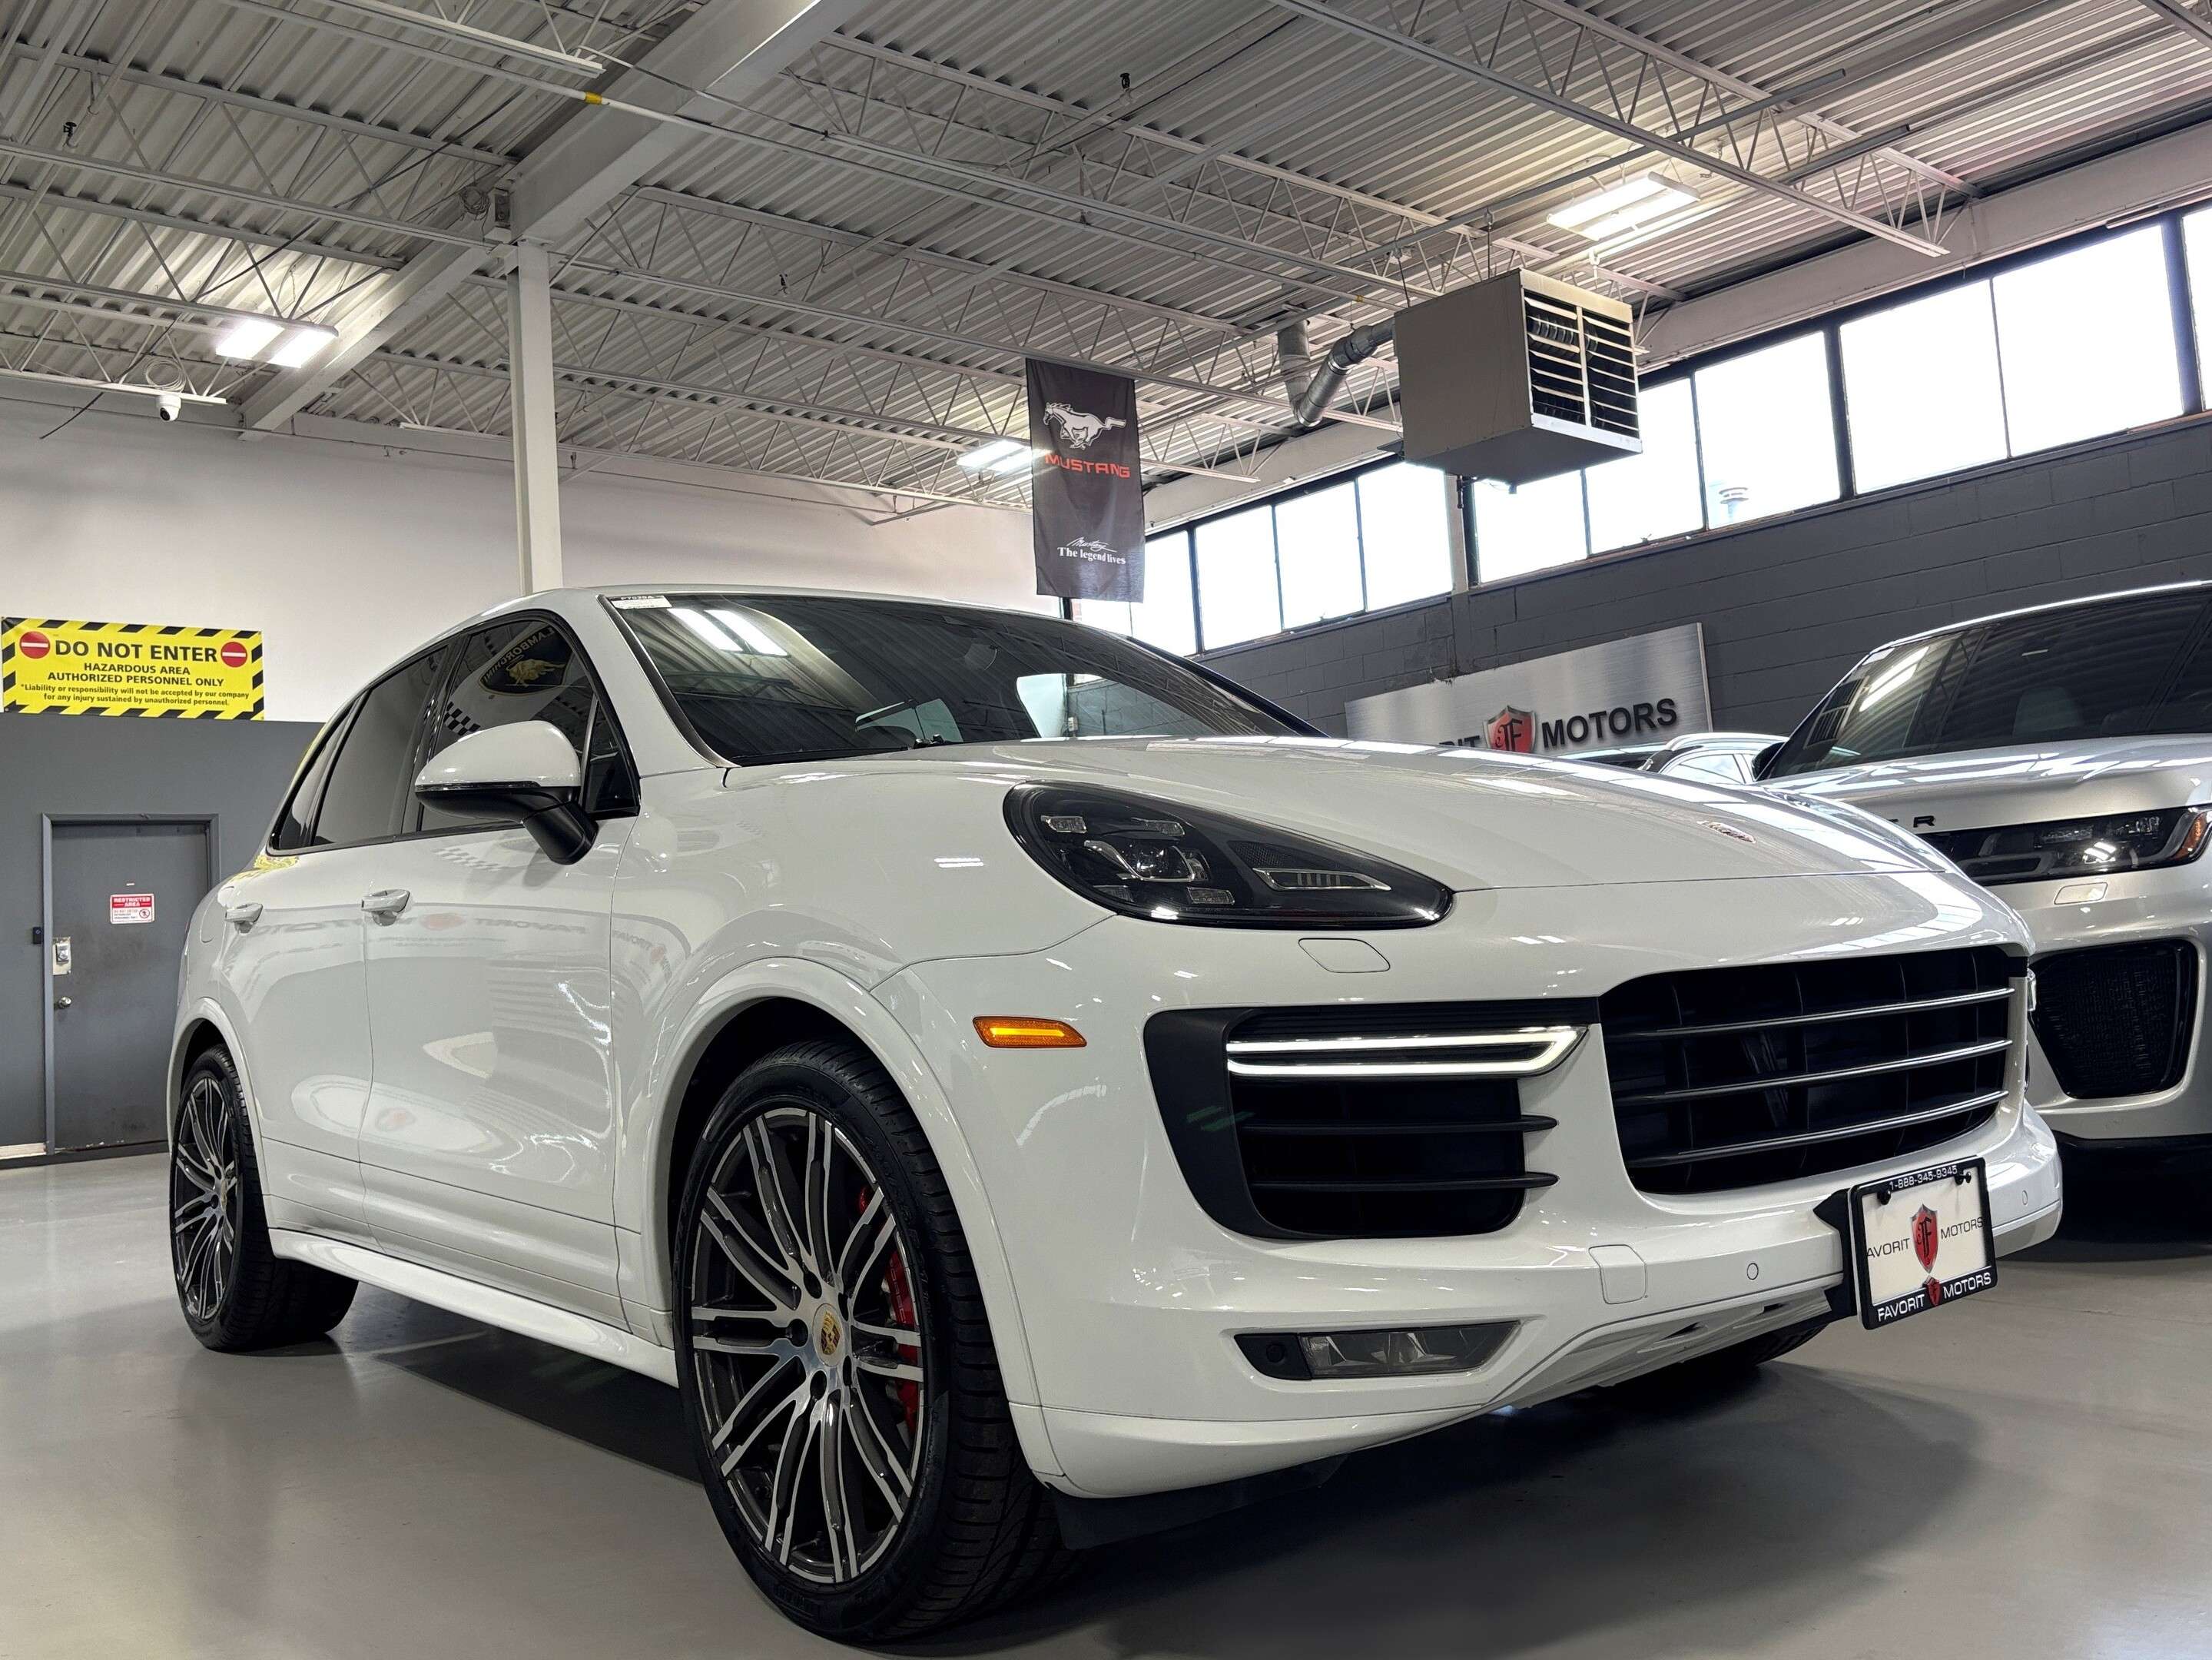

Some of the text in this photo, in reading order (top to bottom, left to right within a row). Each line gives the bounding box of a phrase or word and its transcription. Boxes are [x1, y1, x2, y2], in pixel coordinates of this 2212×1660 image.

[1045, 454, 1130, 478] MUSTANG
[1057, 547, 1126, 565] The legend lives
[55, 640, 217, 662] DO NOT ENTER
[48, 672, 224, 686] AUTHORIZED PERSONNEL ONLY
[84, 662, 191, 676] HAZARDOUS AREA
[68, 686, 118, 695] responsibility
[73, 694, 95, 703] injury
[144, 696, 191, 705] unauthorized
[1541, 698, 1677, 749] MOTORS
[1889, 1165, 1958, 1190] 1-888-345-9345
[1866, 1238, 1910, 1258] AVORIT
[1940, 1217, 1984, 1240] MOTORS
[1877, 1294, 1925, 1322] FAVORIT
[1942, 1272, 1992, 1299] MOTORS
